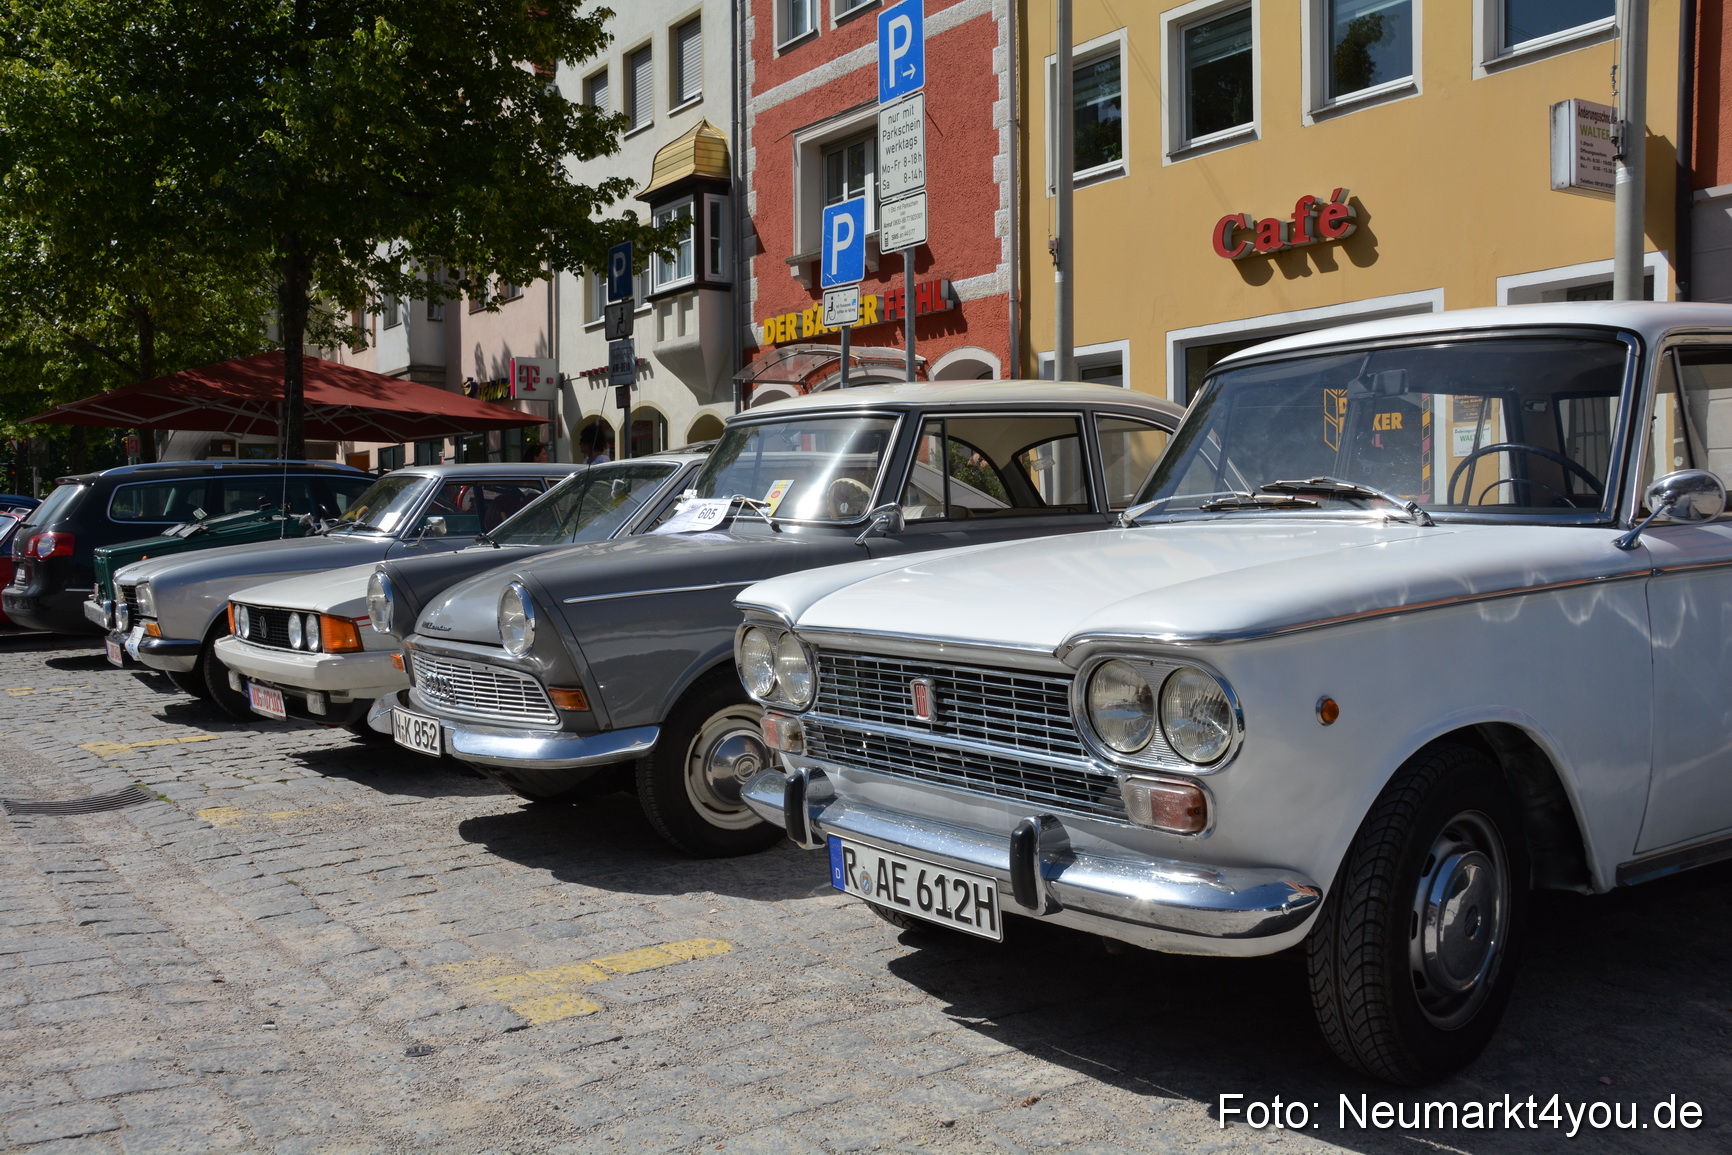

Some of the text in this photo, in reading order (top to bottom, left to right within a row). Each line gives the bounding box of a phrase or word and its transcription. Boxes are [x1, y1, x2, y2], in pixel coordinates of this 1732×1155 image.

[889, 14, 912, 89] P
[888, 104, 914, 125] nur mit
[882, 117, 920, 142] Parkschein
[1579, 124, 1611, 141] WALTER
[885, 136, 918, 155] werktags
[882, 159, 900, 175] Mo-Fr
[882, 180, 890, 190] Sa
[1212, 187, 1354, 260] Café
[831, 212, 855, 275] P
[613, 251, 627, 294] P
[763, 313, 798, 346] DER
[883, 279, 948, 322] FEHL
[698, 508, 718, 520] 605
[414, 719, 438, 750] 852
[835, 867, 841, 879] D
[843, 846, 996, 931] R AE 612H
